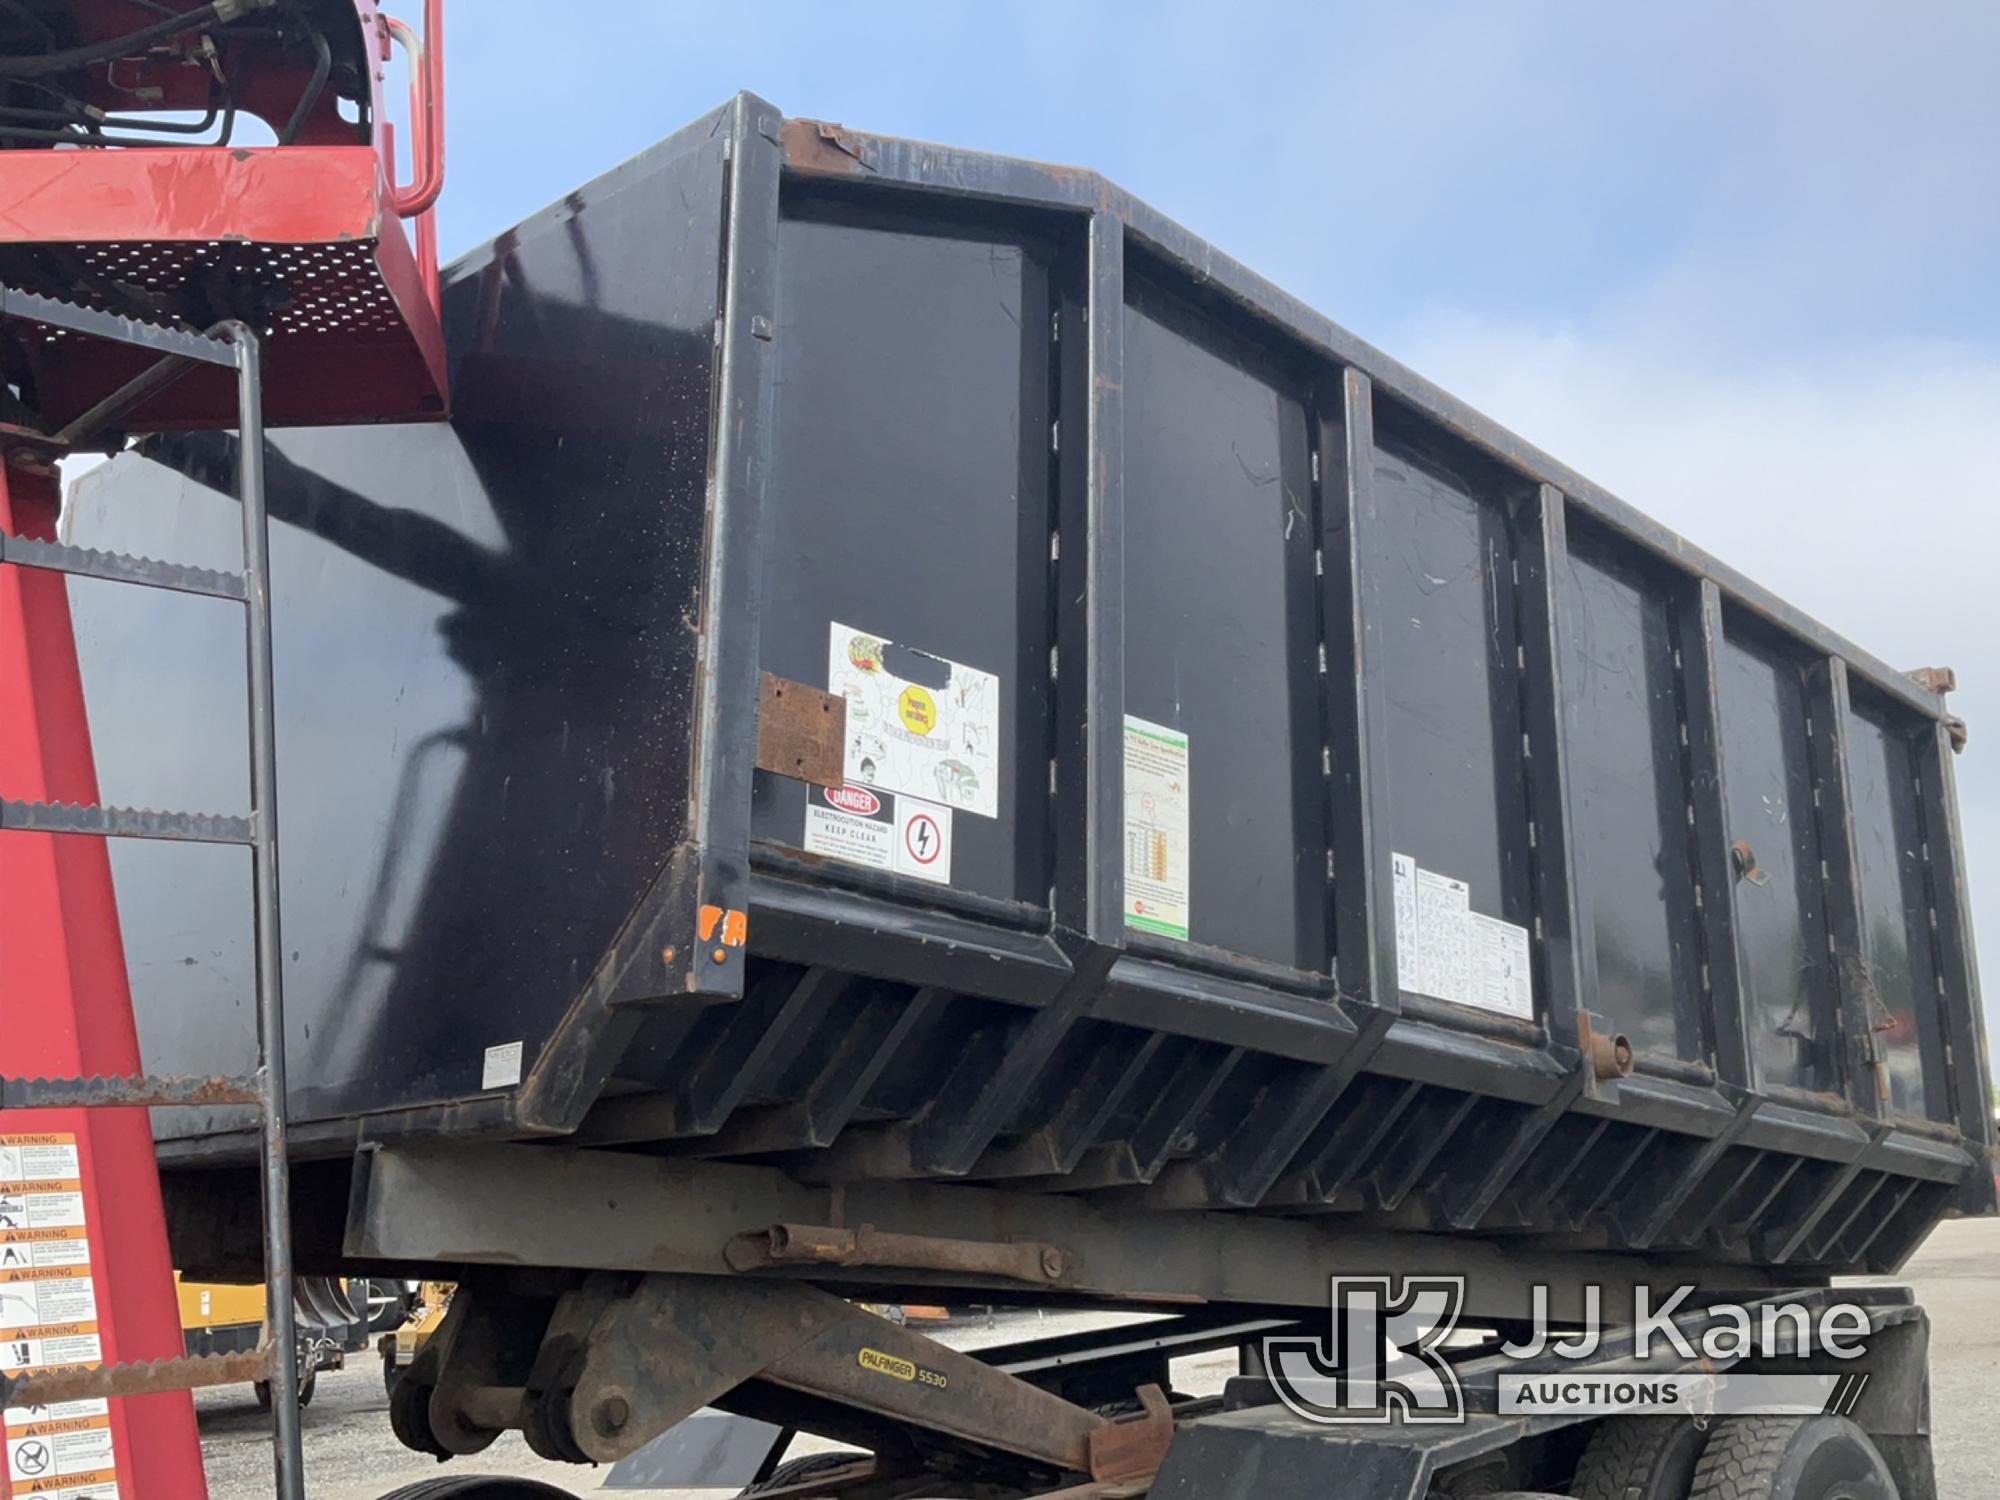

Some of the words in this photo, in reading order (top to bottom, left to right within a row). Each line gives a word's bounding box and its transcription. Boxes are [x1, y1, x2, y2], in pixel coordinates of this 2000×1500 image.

[833, 789, 872, 811] DANGER
[825, 824, 846, 835] KEEP
[850, 830, 877, 843] CLEAR
[7, 1135, 57, 1145] WARNING
[12, 1182, 63, 1193] WARNING
[16, 1229, 68, 1241] WARNING
[21, 1268, 73, 1280] WARNING
[26, 1325, 80, 1338] WARNING
[862, 1351, 913, 1377] PALFINGER
[918, 1369, 947, 1388] 5530
[37, 1419, 91, 1433] WARNING
[43, 1473, 97, 1488] WARNING
